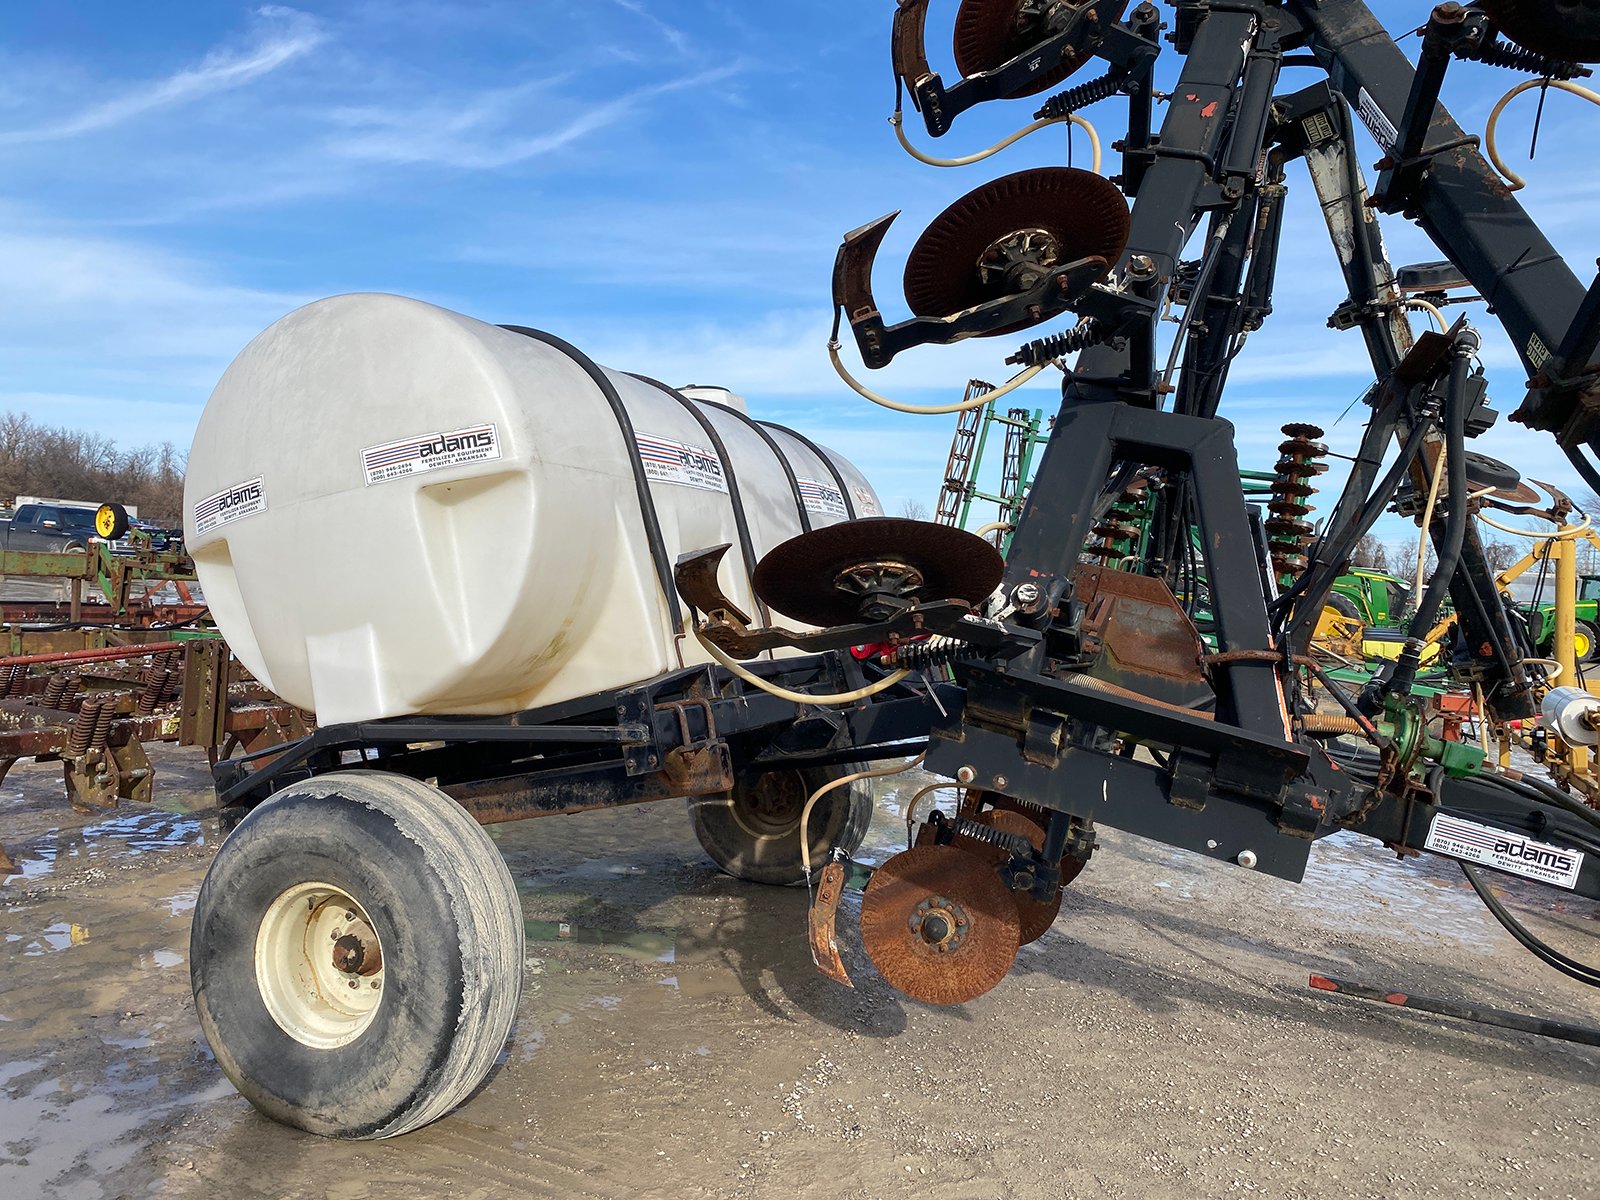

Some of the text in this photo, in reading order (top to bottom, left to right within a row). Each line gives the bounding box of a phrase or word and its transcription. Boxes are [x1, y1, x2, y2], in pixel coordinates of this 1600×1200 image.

[419, 434, 493, 458] adams
[421, 446, 493, 464] FERTILIZER EQUIPMENT
[429, 453, 487, 468] DEWITT, ARKANSAS
[218, 488, 260, 511] adams
[1433, 837, 1450, 846] (870)
[1493, 839, 1571, 871] adams
[1497, 860, 1560, 881] DEWITT, ARKANSAS
